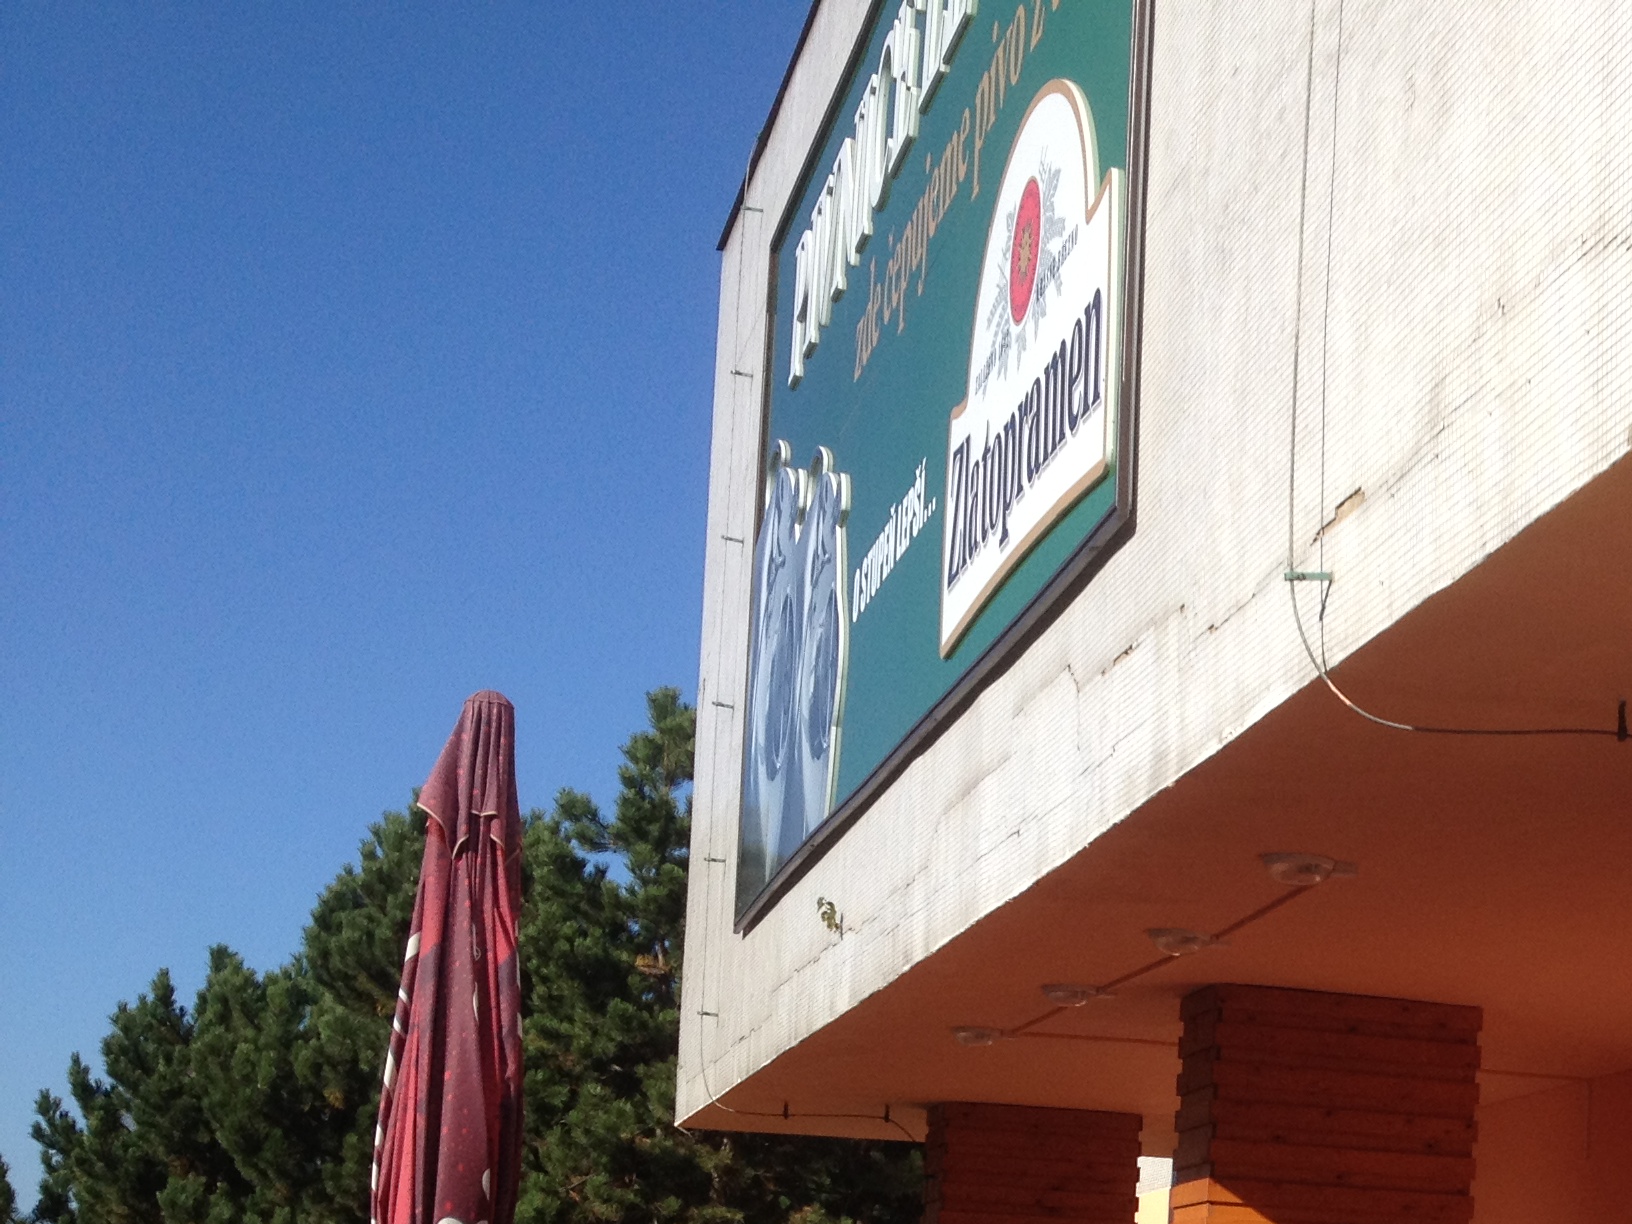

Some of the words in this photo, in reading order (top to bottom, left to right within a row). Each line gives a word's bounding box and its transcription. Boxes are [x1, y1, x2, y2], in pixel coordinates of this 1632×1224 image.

[854, 255, 881, 383] zde
[971, 4, 1026, 201] pivo
[852, 568, 861, 623] O
[860, 503, 897, 614] STUPEŇ
[947, 287, 1103, 592] Zlatopramen
